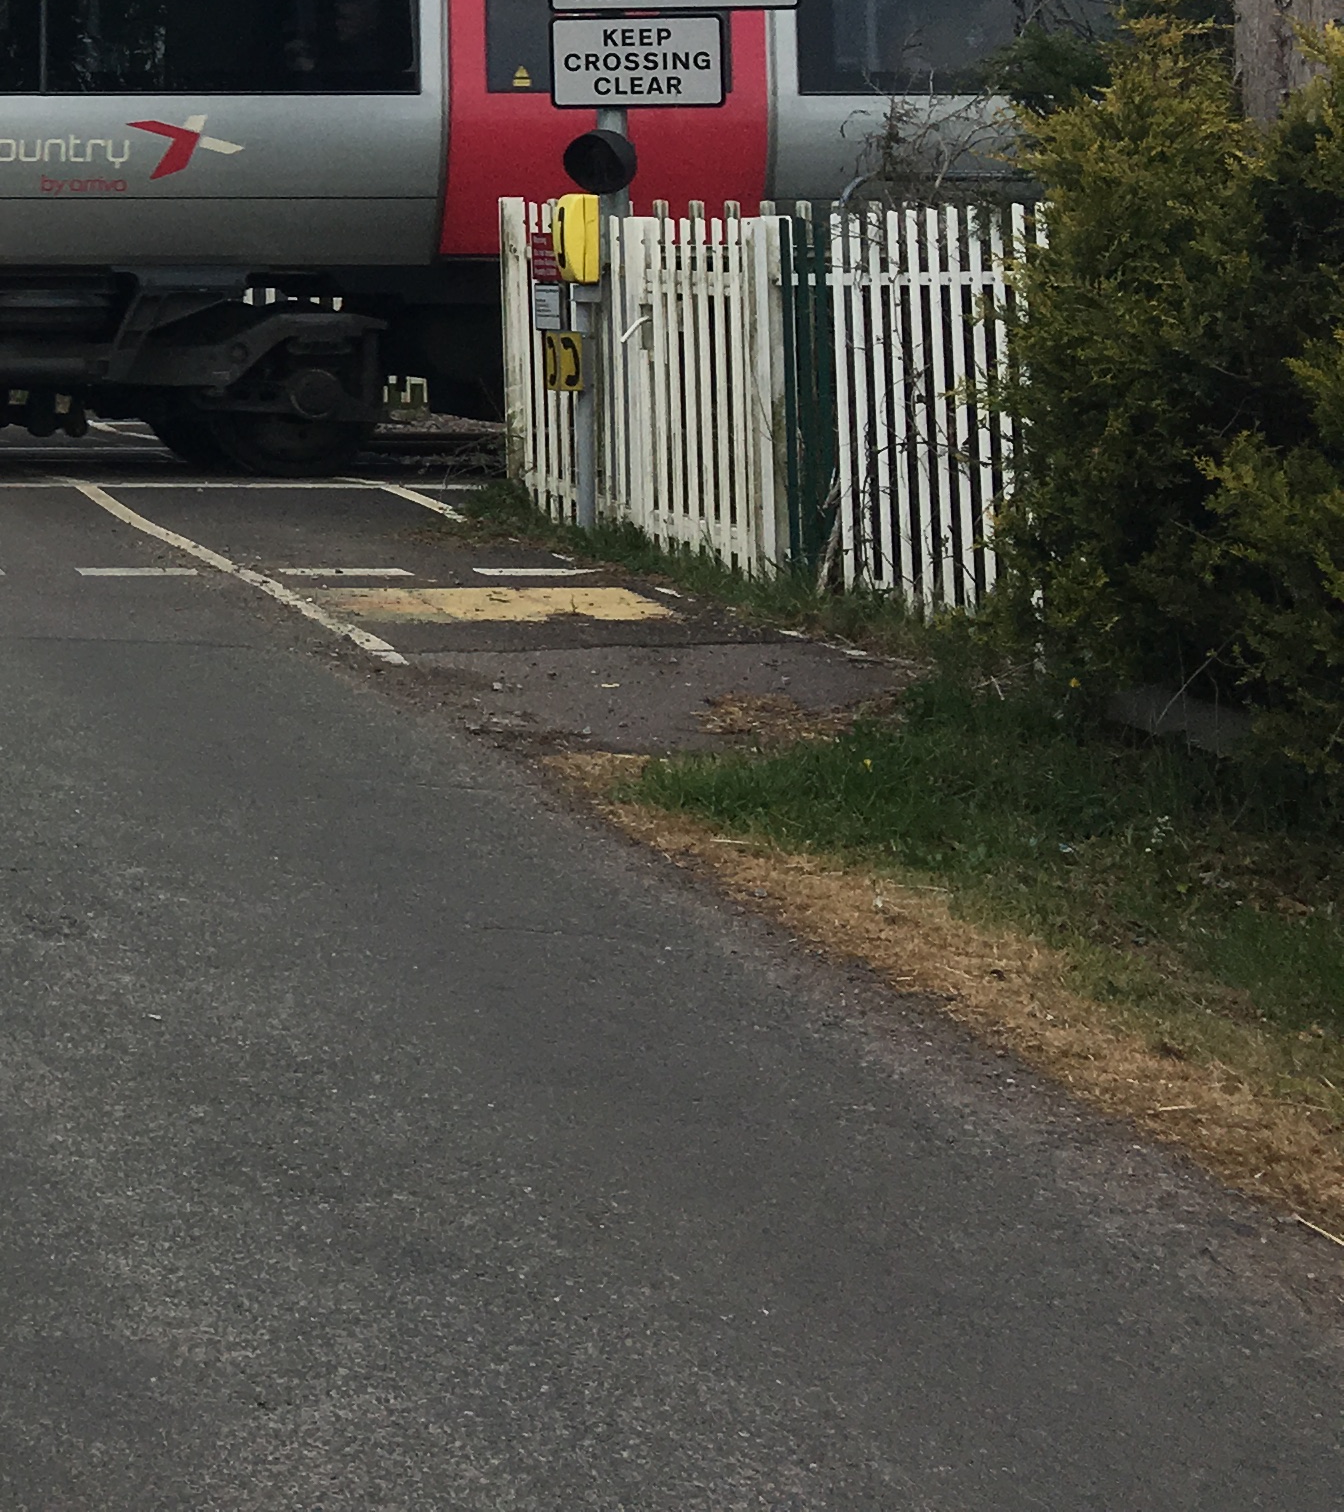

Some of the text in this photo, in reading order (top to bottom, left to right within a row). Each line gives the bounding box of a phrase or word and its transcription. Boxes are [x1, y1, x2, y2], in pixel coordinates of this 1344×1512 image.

[602, 28, 672, 47] KEEP
[564, 51, 711, 72] CROSSING
[593, 76, 682, 95] CLEAR
